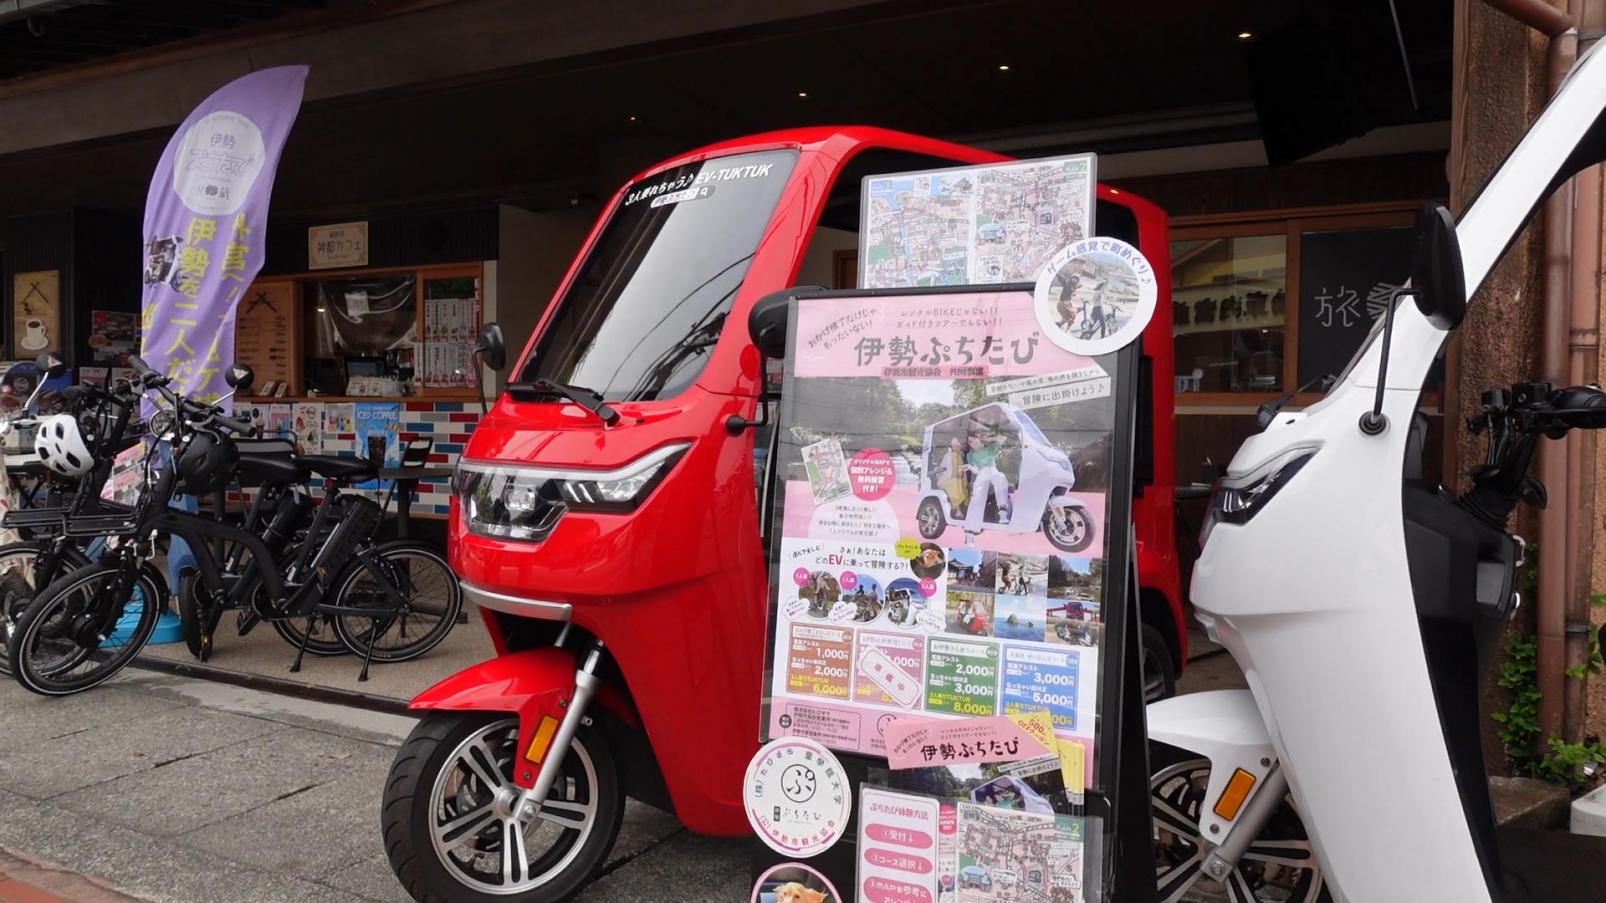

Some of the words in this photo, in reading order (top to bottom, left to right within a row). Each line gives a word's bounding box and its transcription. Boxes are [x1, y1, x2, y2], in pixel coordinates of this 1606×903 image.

[695, 163, 774, 186] EV-TUKTUK
[1314, 286, 1361, 328] 旅
[854, 331, 1040, 367] 伊勢ぷちたび
[815, 666, 848, 678] 2,000円
[955, 663, 994, 678] 2,000円
[1033, 672, 1074, 687] 3,000円
[954, 682, 993, 697] 3,000円
[1032, 692, 1074, 707] 5,000円
[953, 702, 992, 716] 8,000円
[920, 736, 1019, 762] 伊勢ぷちたび
